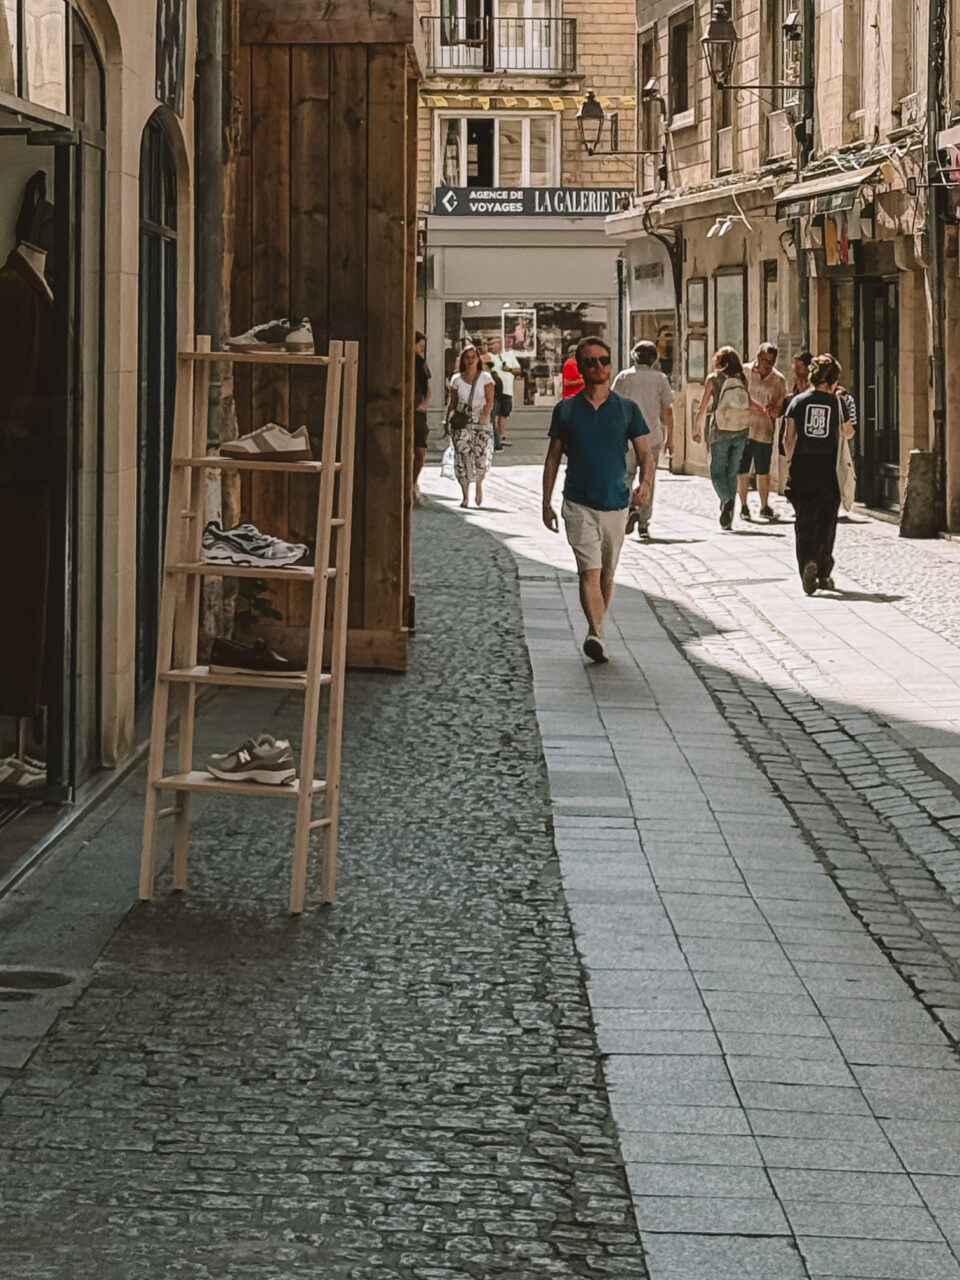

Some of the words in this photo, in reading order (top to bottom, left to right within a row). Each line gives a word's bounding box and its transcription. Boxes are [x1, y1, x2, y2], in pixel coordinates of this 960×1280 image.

[469, 191, 507, 199] AGENCE
[510, 191, 523, 199] DE
[535, 191, 552, 213] LA
[554, 190, 608, 213] GALERIE
[469, 202, 524, 212] VOYAGES
